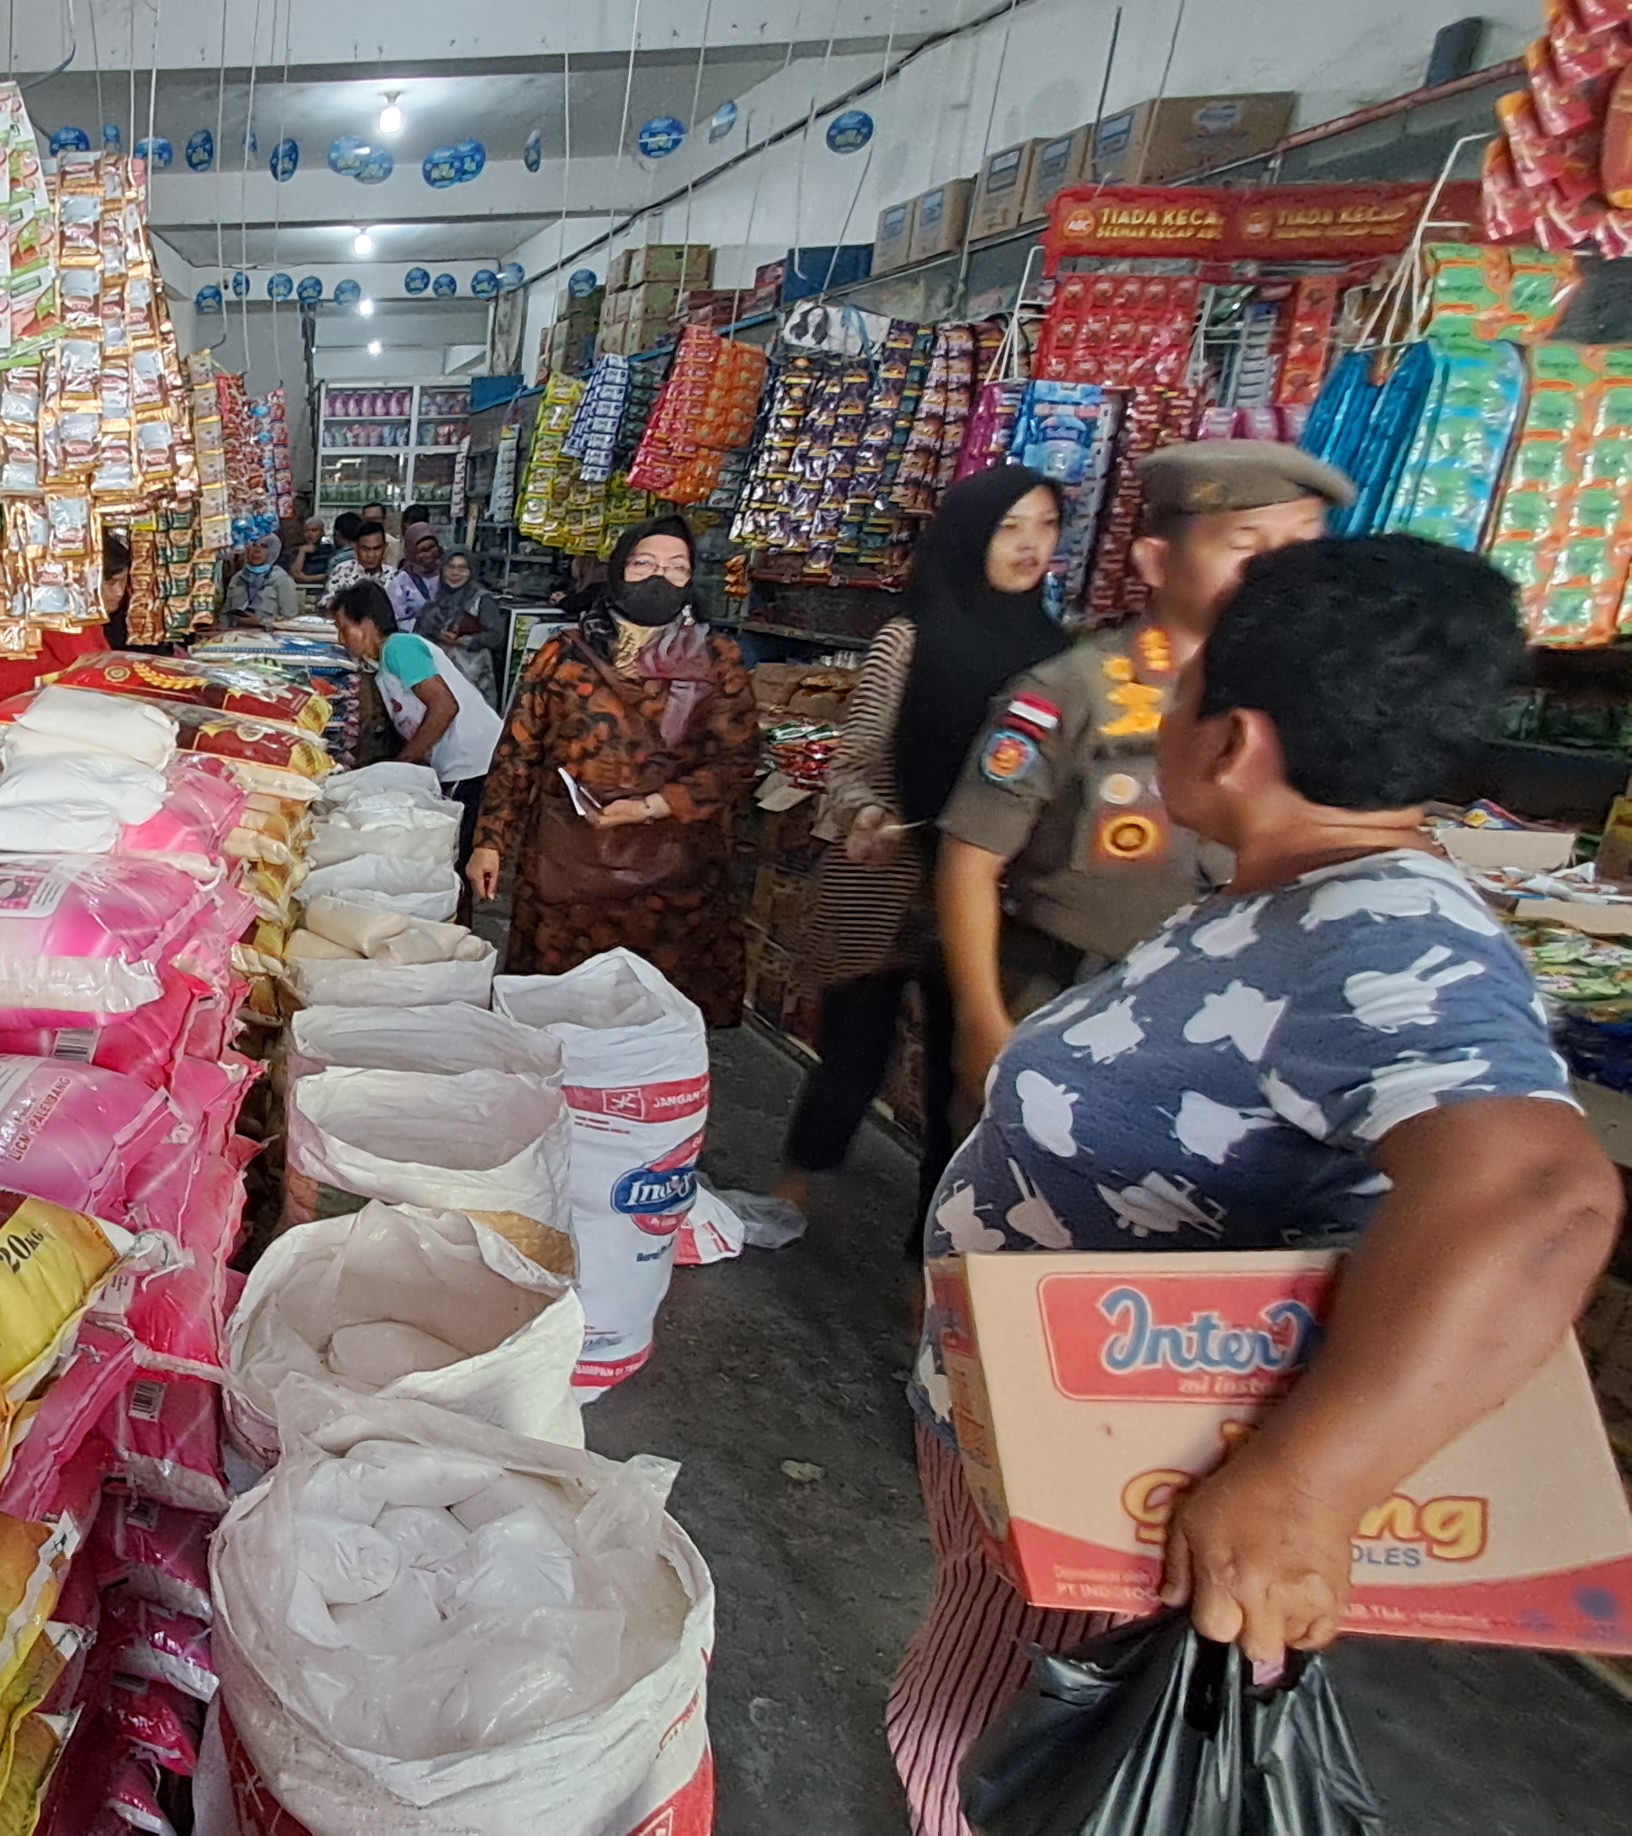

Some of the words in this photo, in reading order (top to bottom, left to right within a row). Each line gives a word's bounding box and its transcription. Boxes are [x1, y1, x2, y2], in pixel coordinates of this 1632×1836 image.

[1099, 207, 1157, 225] TIADA
[652, 1091, 700, 1109] JANGAN
[1122, 1467, 1490, 1563] Gng
